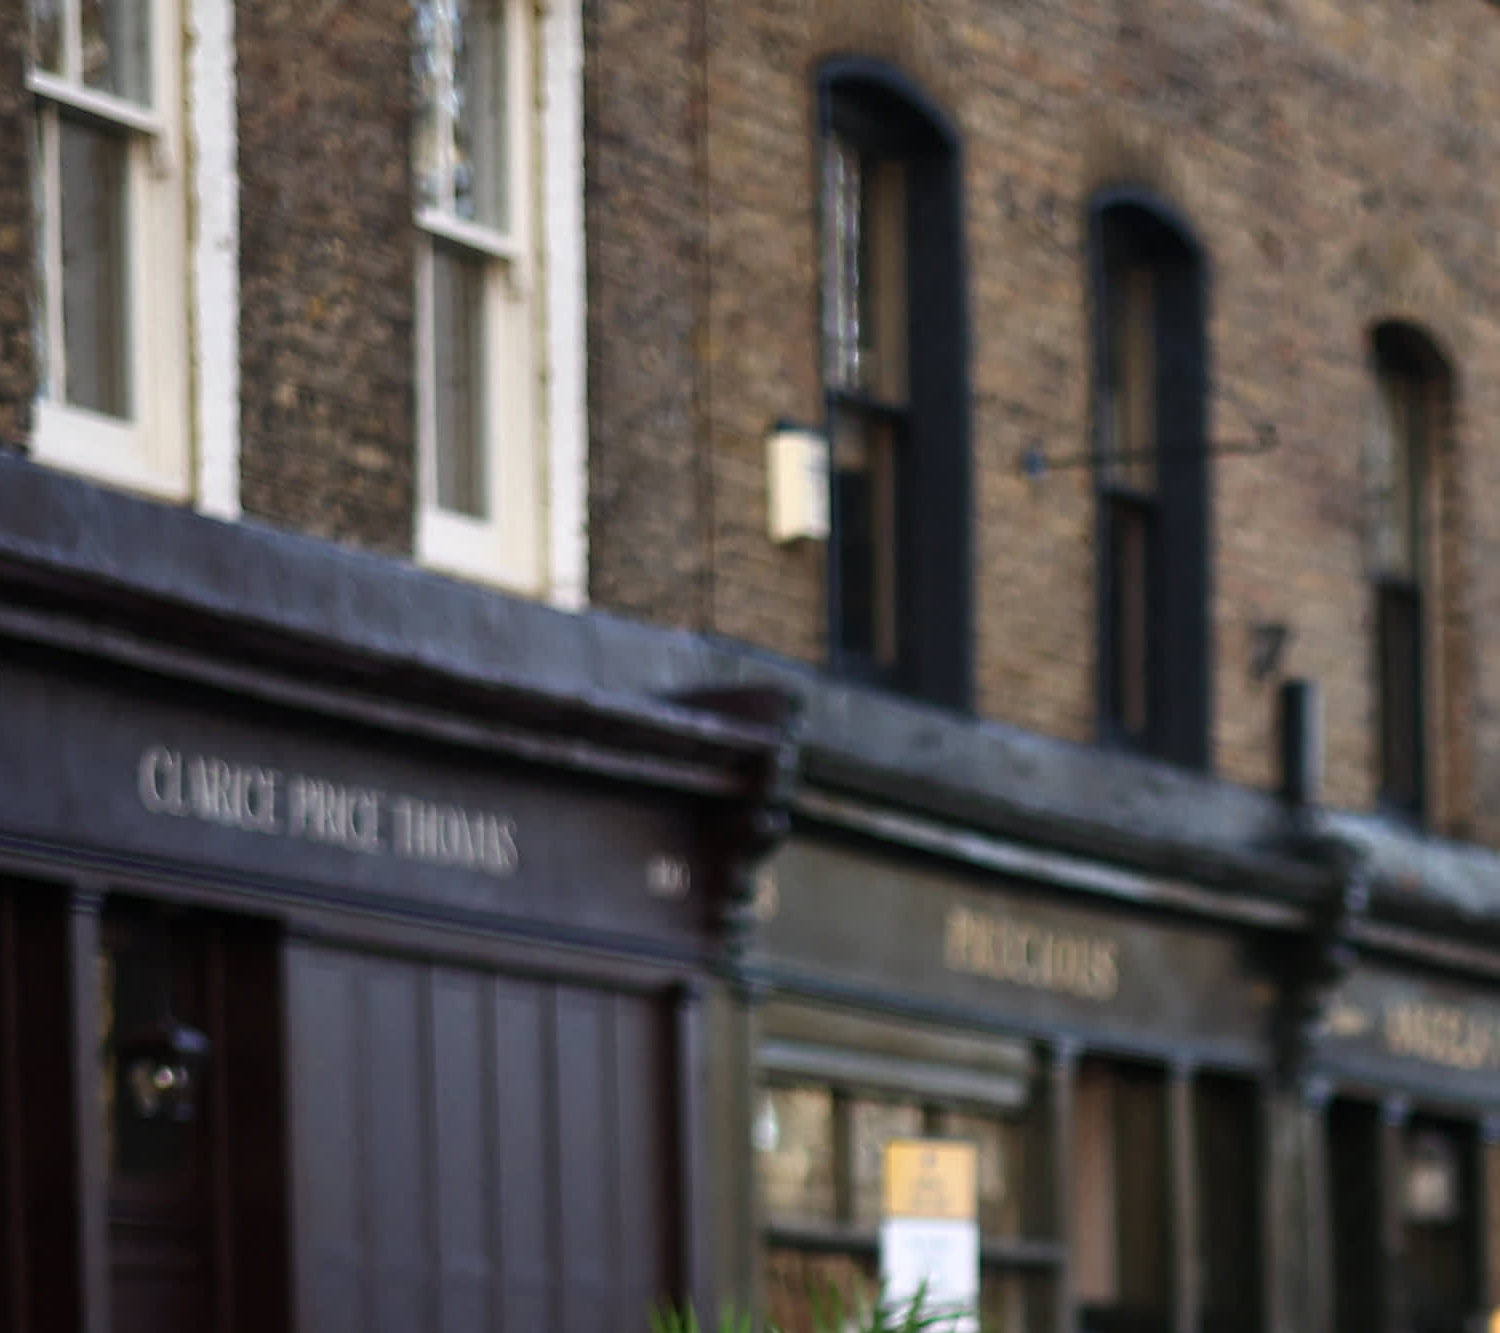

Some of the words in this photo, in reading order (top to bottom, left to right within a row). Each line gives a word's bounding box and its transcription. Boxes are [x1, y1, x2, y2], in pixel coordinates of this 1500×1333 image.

[138, 744, 279, 834] CLARICE
[288, 774, 383, 854] PRICE
[392, 794, 518, 877] THOMAS
